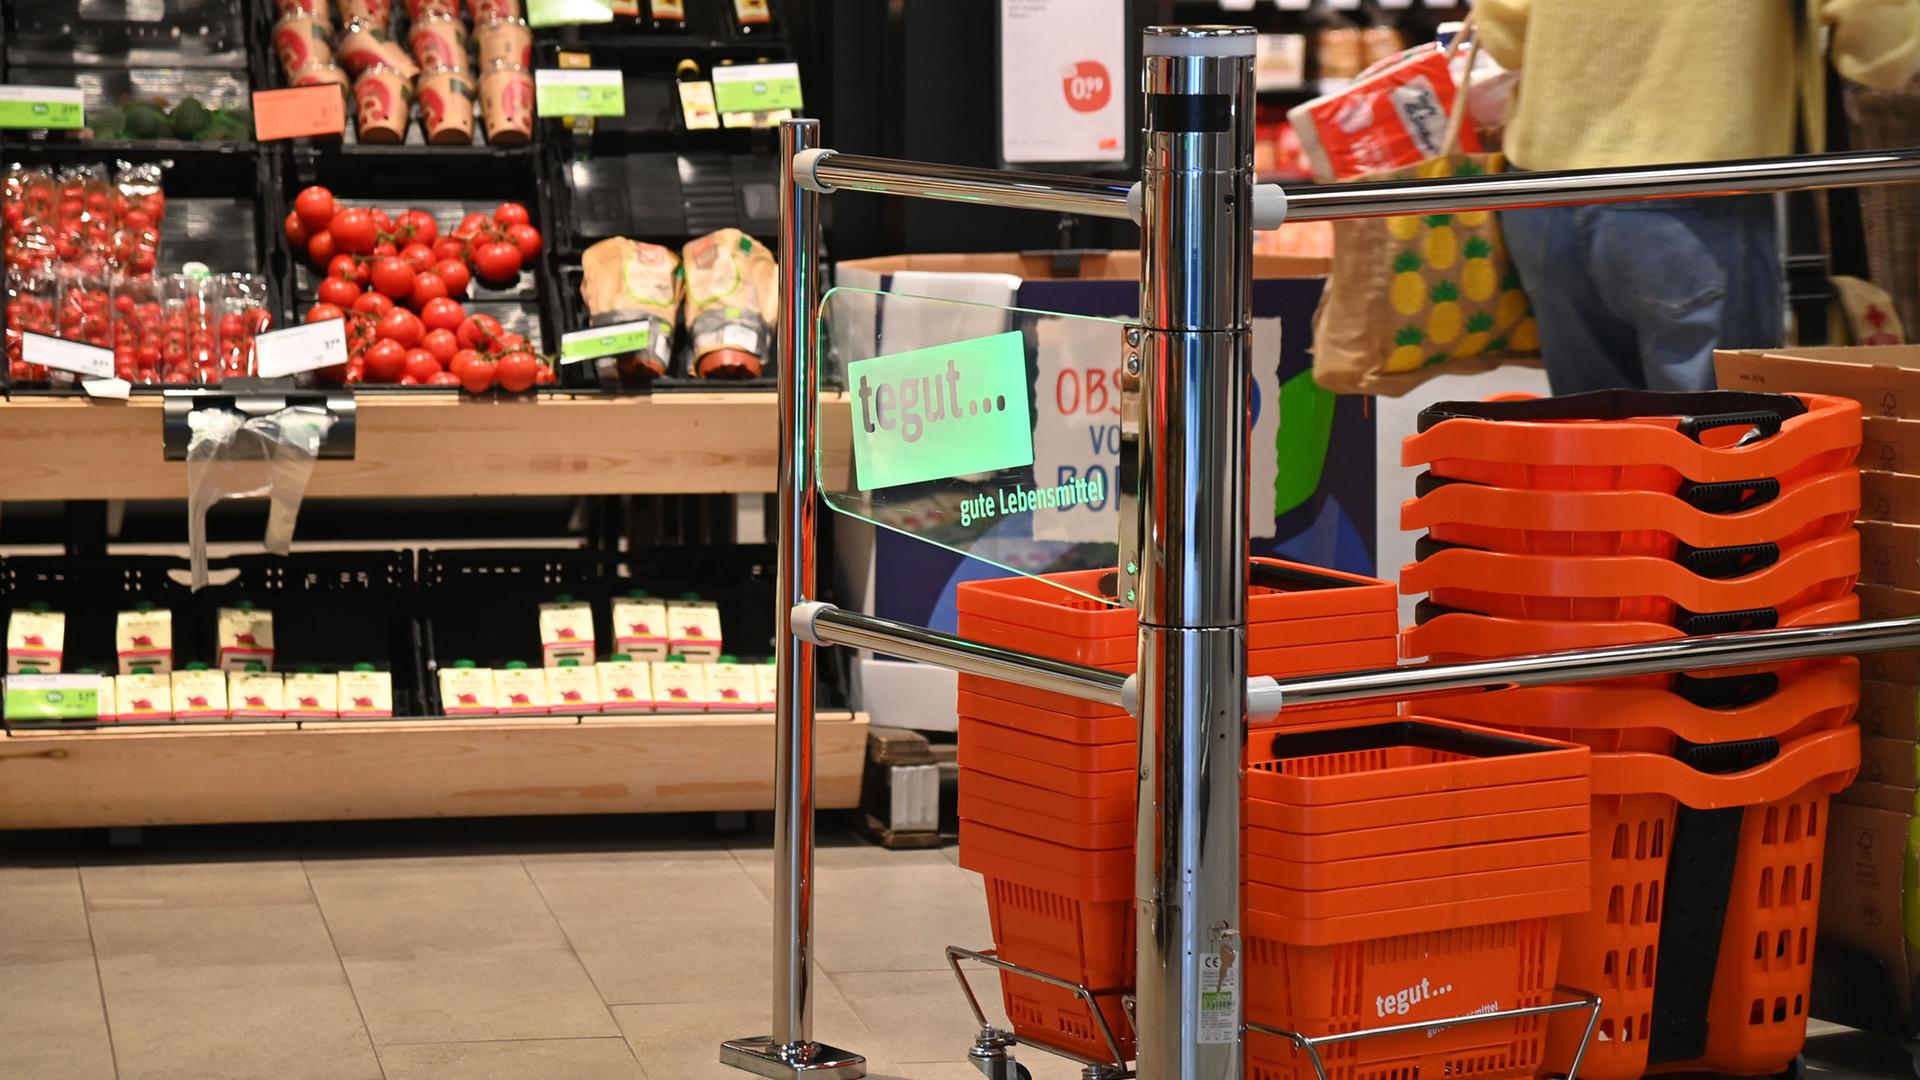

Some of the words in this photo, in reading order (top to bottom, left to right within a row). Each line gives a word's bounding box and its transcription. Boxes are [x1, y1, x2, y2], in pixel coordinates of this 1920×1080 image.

[859, 359, 1006, 443] tegut...
[960, 493, 995, 527] gute
[999, 472, 1104, 515] Lebensmittel
[1057, 464, 1120, 513] BO
[1376, 977, 1453, 1018] tegut...
